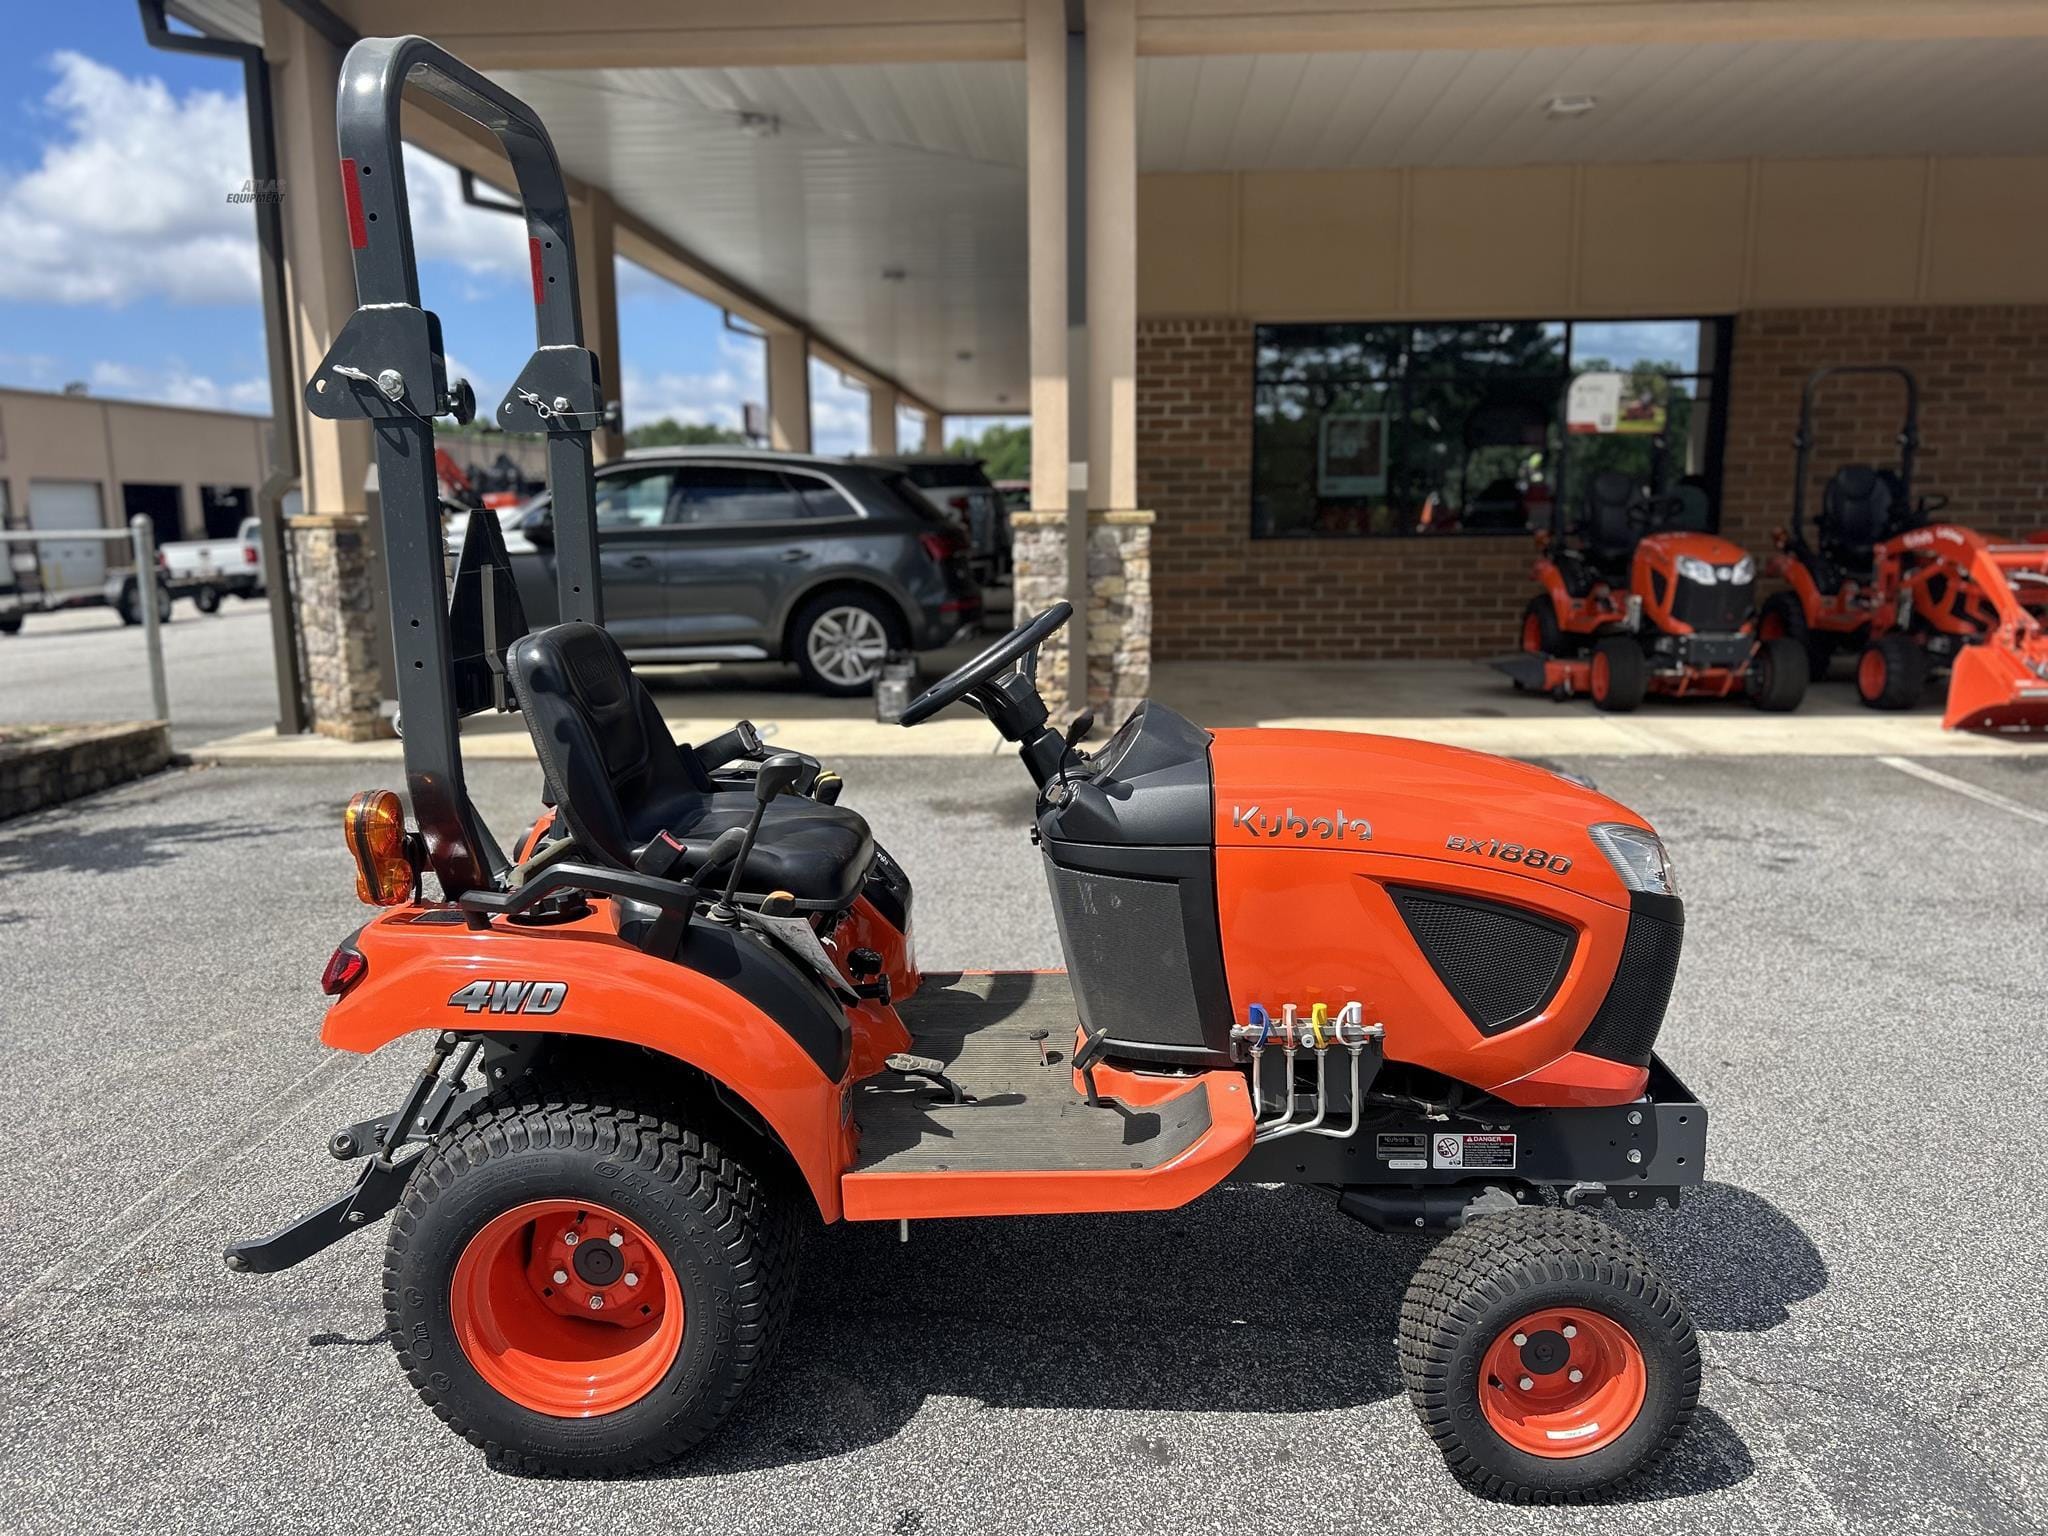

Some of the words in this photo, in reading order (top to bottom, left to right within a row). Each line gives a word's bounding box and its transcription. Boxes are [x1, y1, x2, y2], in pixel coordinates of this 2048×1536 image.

[1233, 804, 1373, 841] Kubota
[1445, 835, 1573, 875] BX1880
[447, 979, 568, 1015] 4WD
